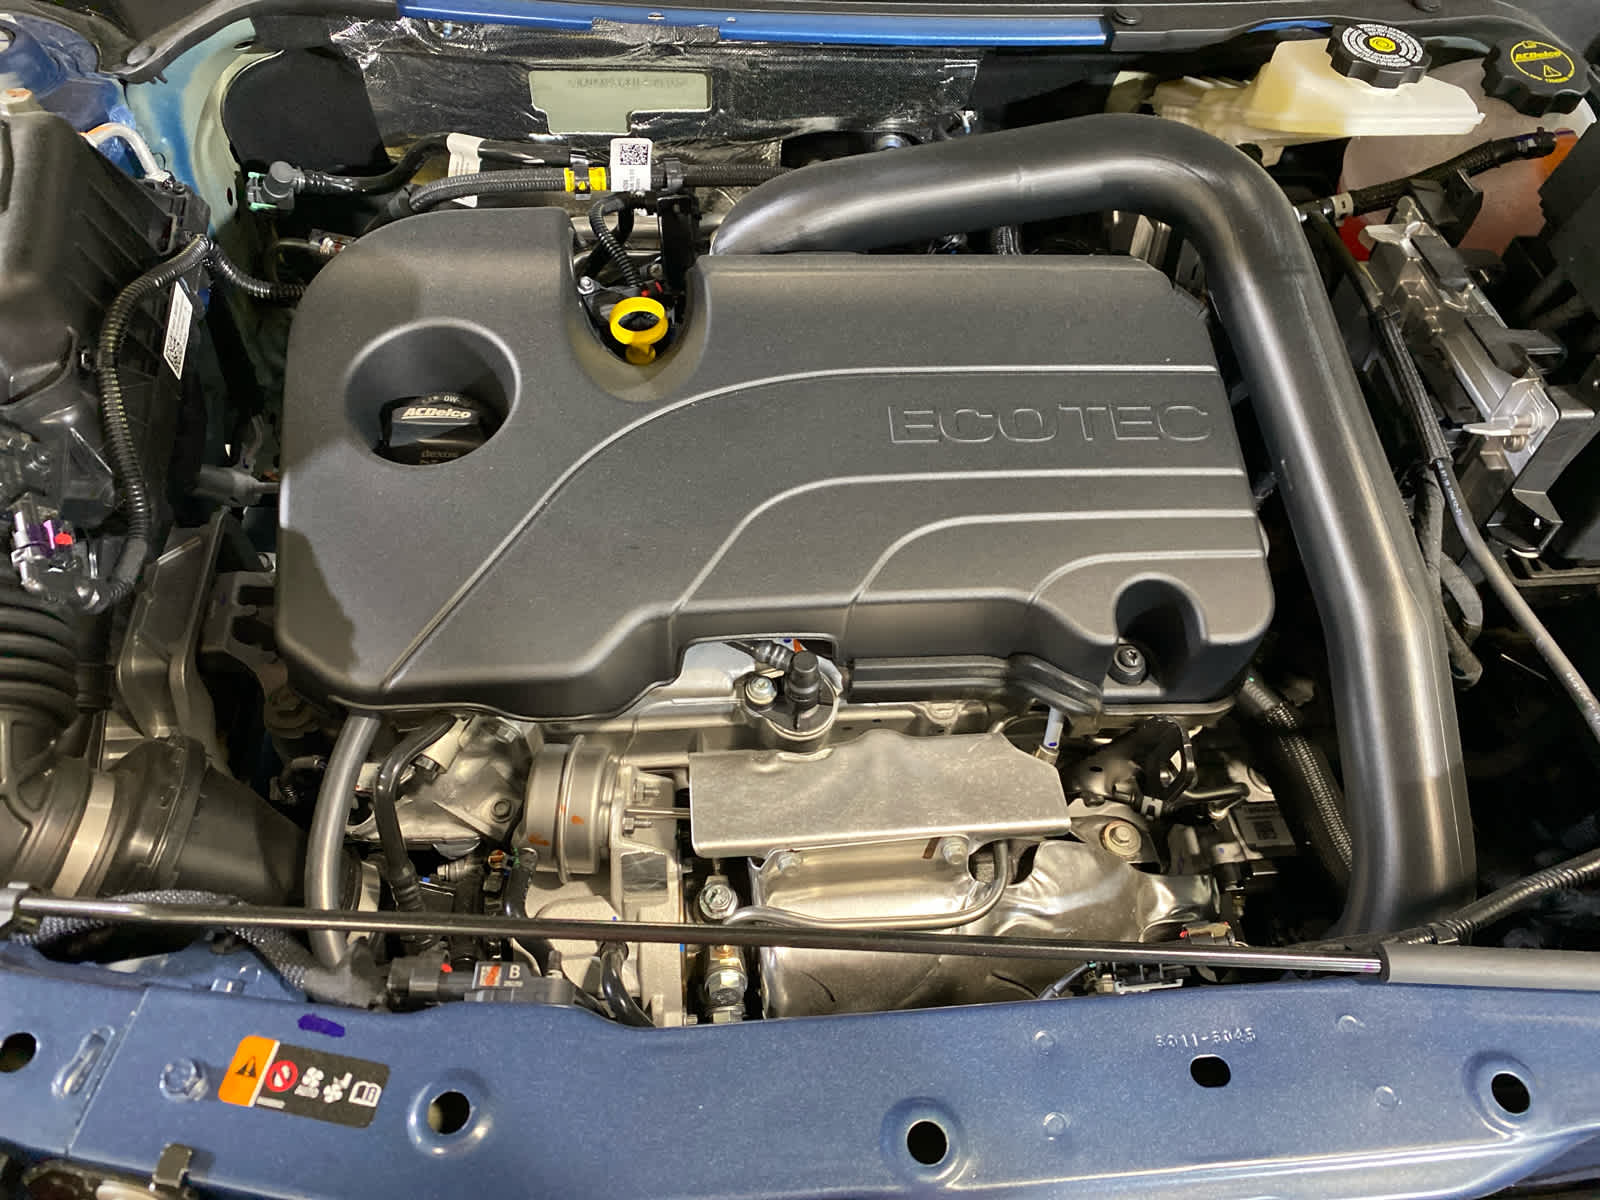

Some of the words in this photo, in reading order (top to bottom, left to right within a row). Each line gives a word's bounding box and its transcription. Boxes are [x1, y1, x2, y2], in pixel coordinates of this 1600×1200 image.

[401, 406, 472, 420] ACDelco
[887, 403, 1211, 444] ECOTEC
[509, 964, 521, 979] B
